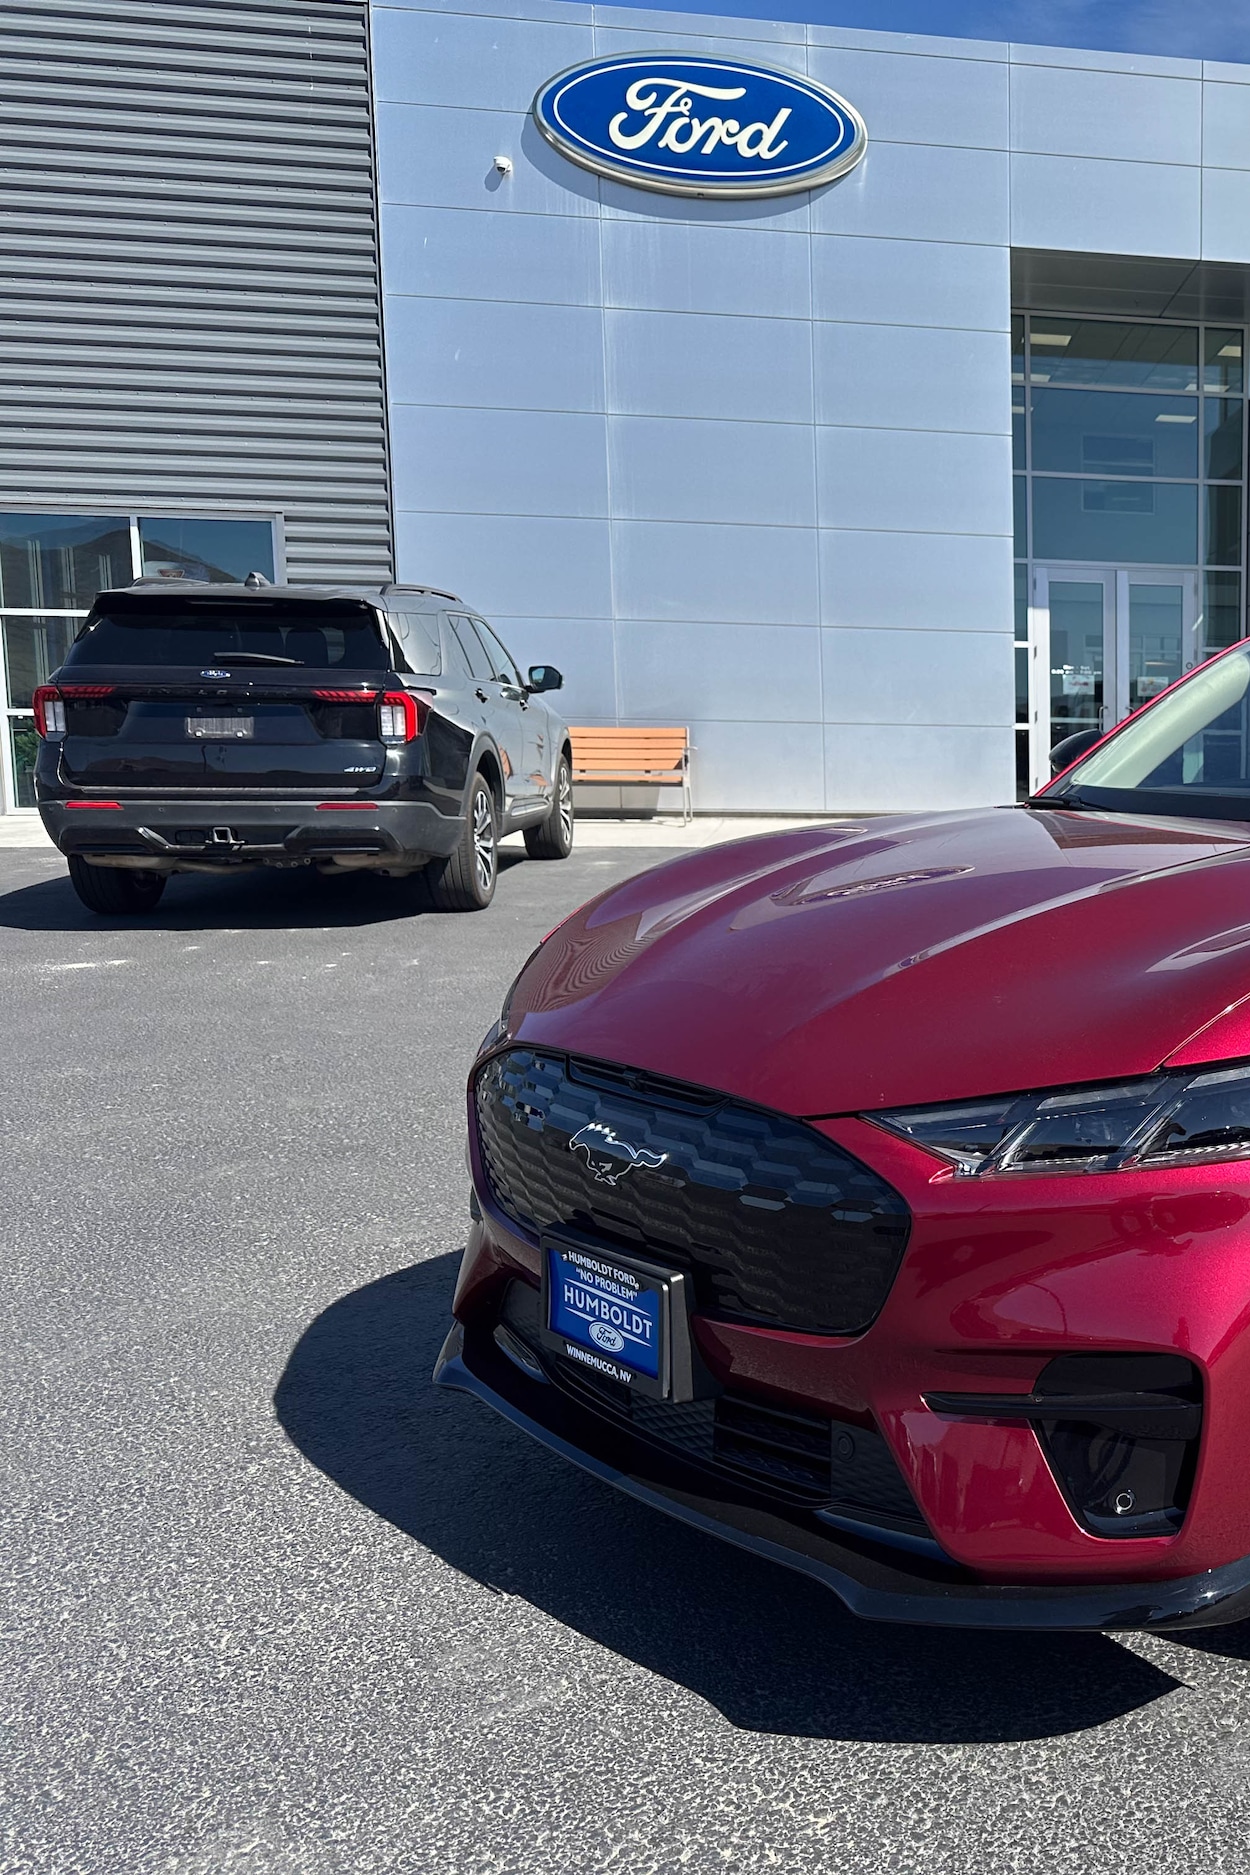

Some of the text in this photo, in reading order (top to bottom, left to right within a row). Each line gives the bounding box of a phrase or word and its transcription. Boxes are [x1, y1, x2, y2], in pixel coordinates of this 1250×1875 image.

[608, 77, 793, 160] Ford
[568, 1250, 636, 1286] HUMBOLDT FORD
[564, 1284, 653, 1339] HUMBOLDT
[596, 1325, 617, 1348] Ford
[566, 1343, 632, 1384] WINNEMUCCA, NV
